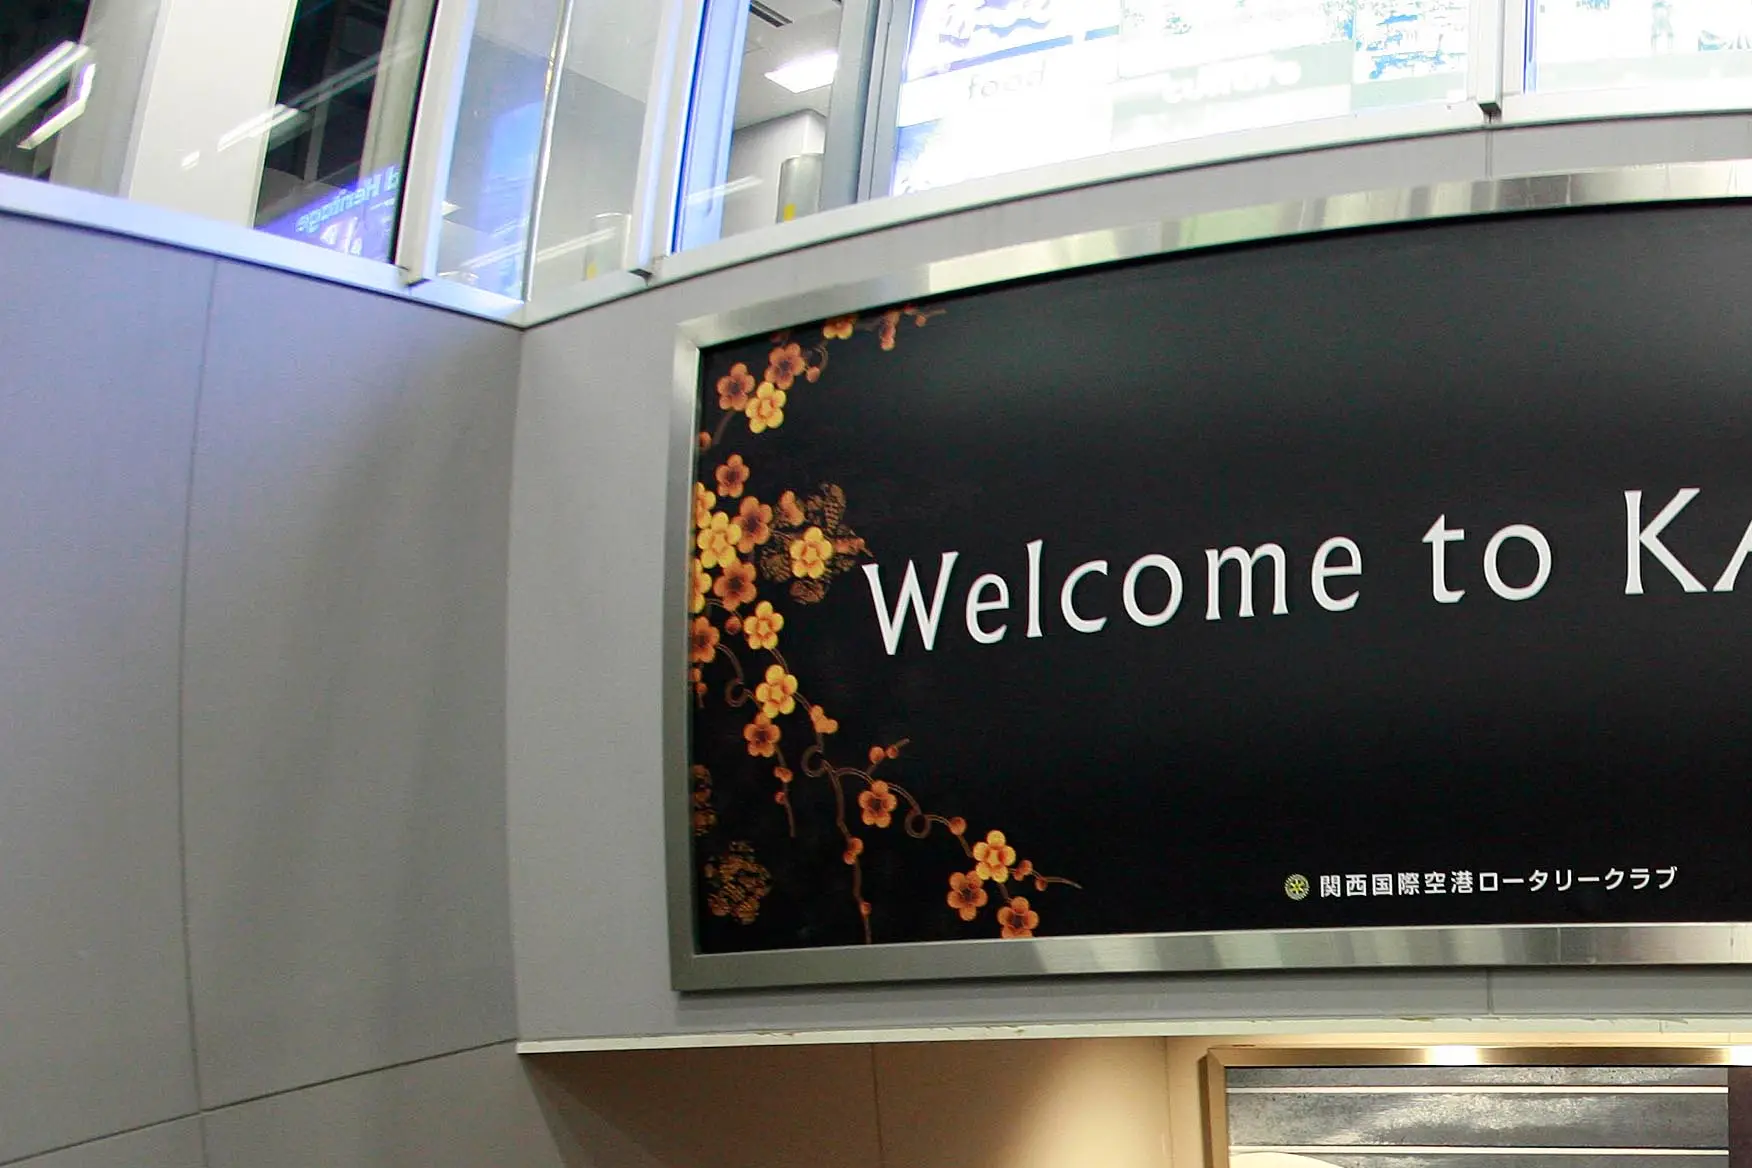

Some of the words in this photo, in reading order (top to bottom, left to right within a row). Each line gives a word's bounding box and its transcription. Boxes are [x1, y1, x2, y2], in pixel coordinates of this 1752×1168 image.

[968, 62, 1047, 102] food
[861, 535, 1363, 656] Welcome
[1421, 513, 1552, 604] to
[1319, 865, 1679, 898] 関西国際空港ロータリークラブ
